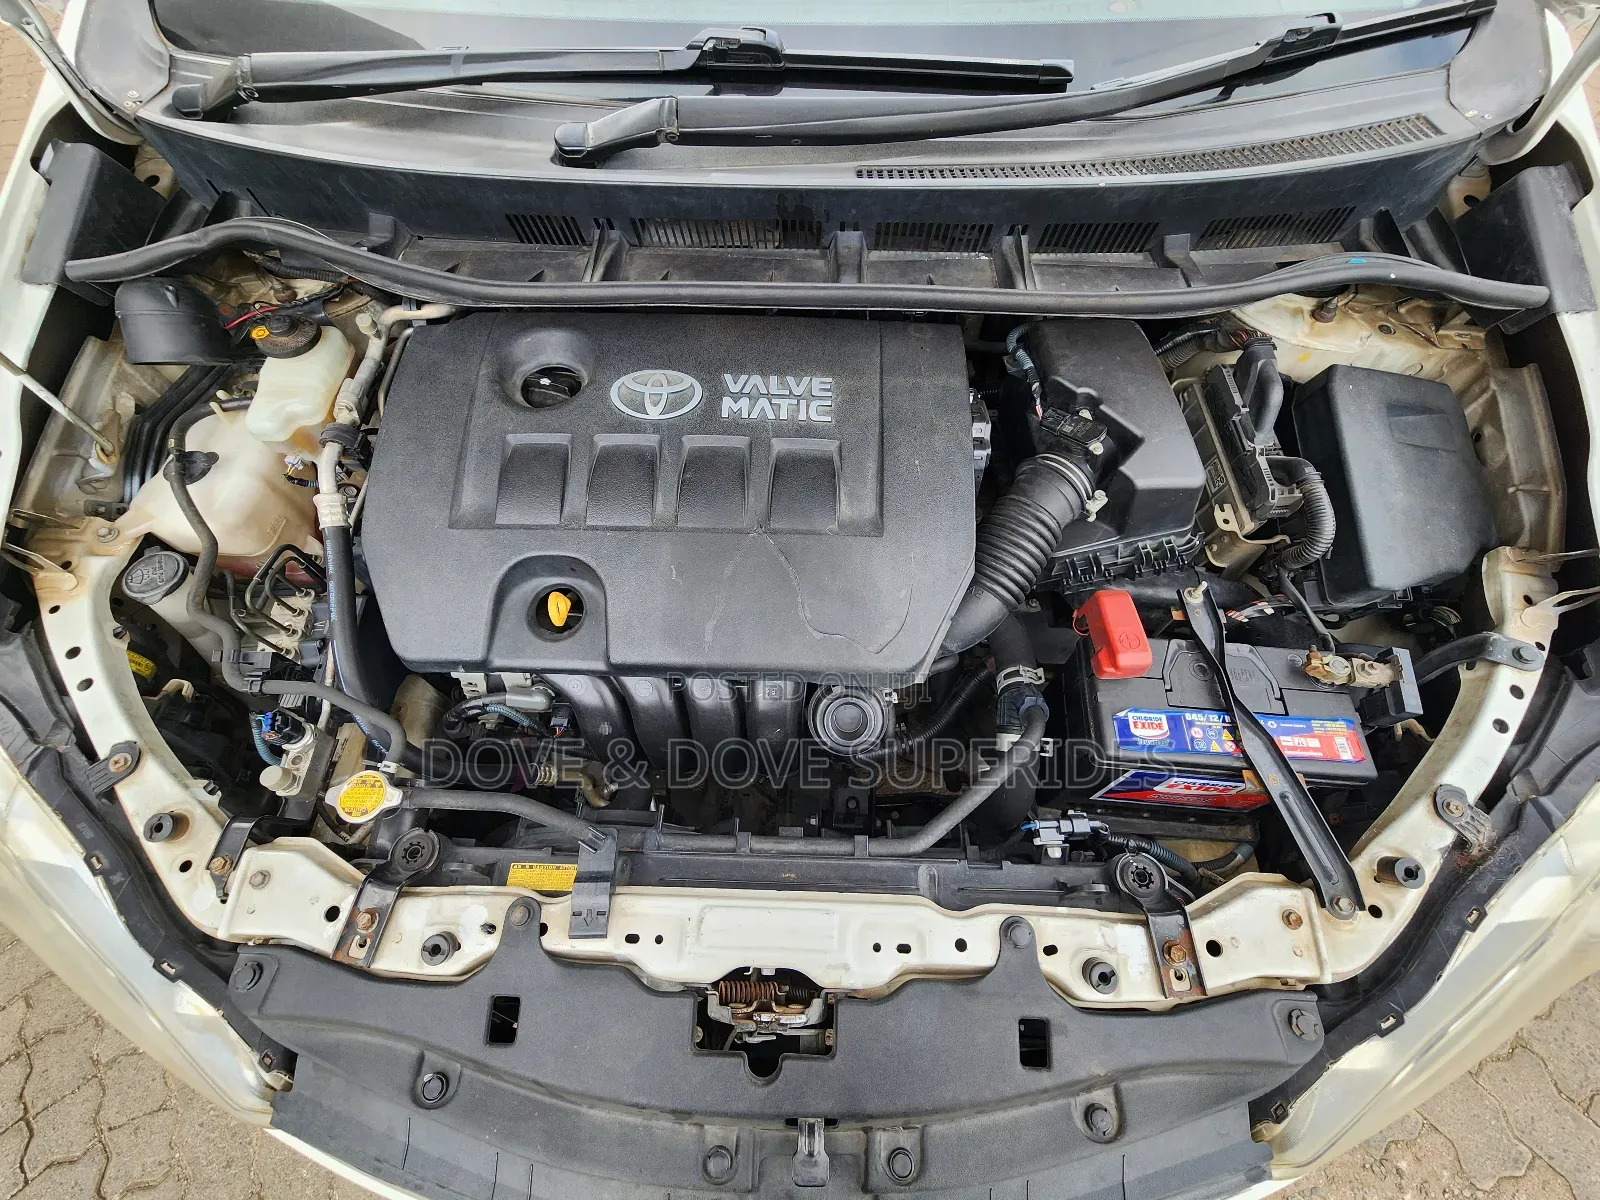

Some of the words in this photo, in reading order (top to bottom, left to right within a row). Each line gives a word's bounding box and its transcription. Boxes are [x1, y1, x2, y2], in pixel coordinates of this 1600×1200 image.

[723, 373, 833, 397] VALVE
[721, 396, 832, 422] MATIC
[1131, 714, 1163, 722] CHLORIDE
[1132, 721, 1165, 731] EXIDE
[1165, 783, 1237, 795] EXIDE
[1173, 778, 1242, 790] CHLORIDE
